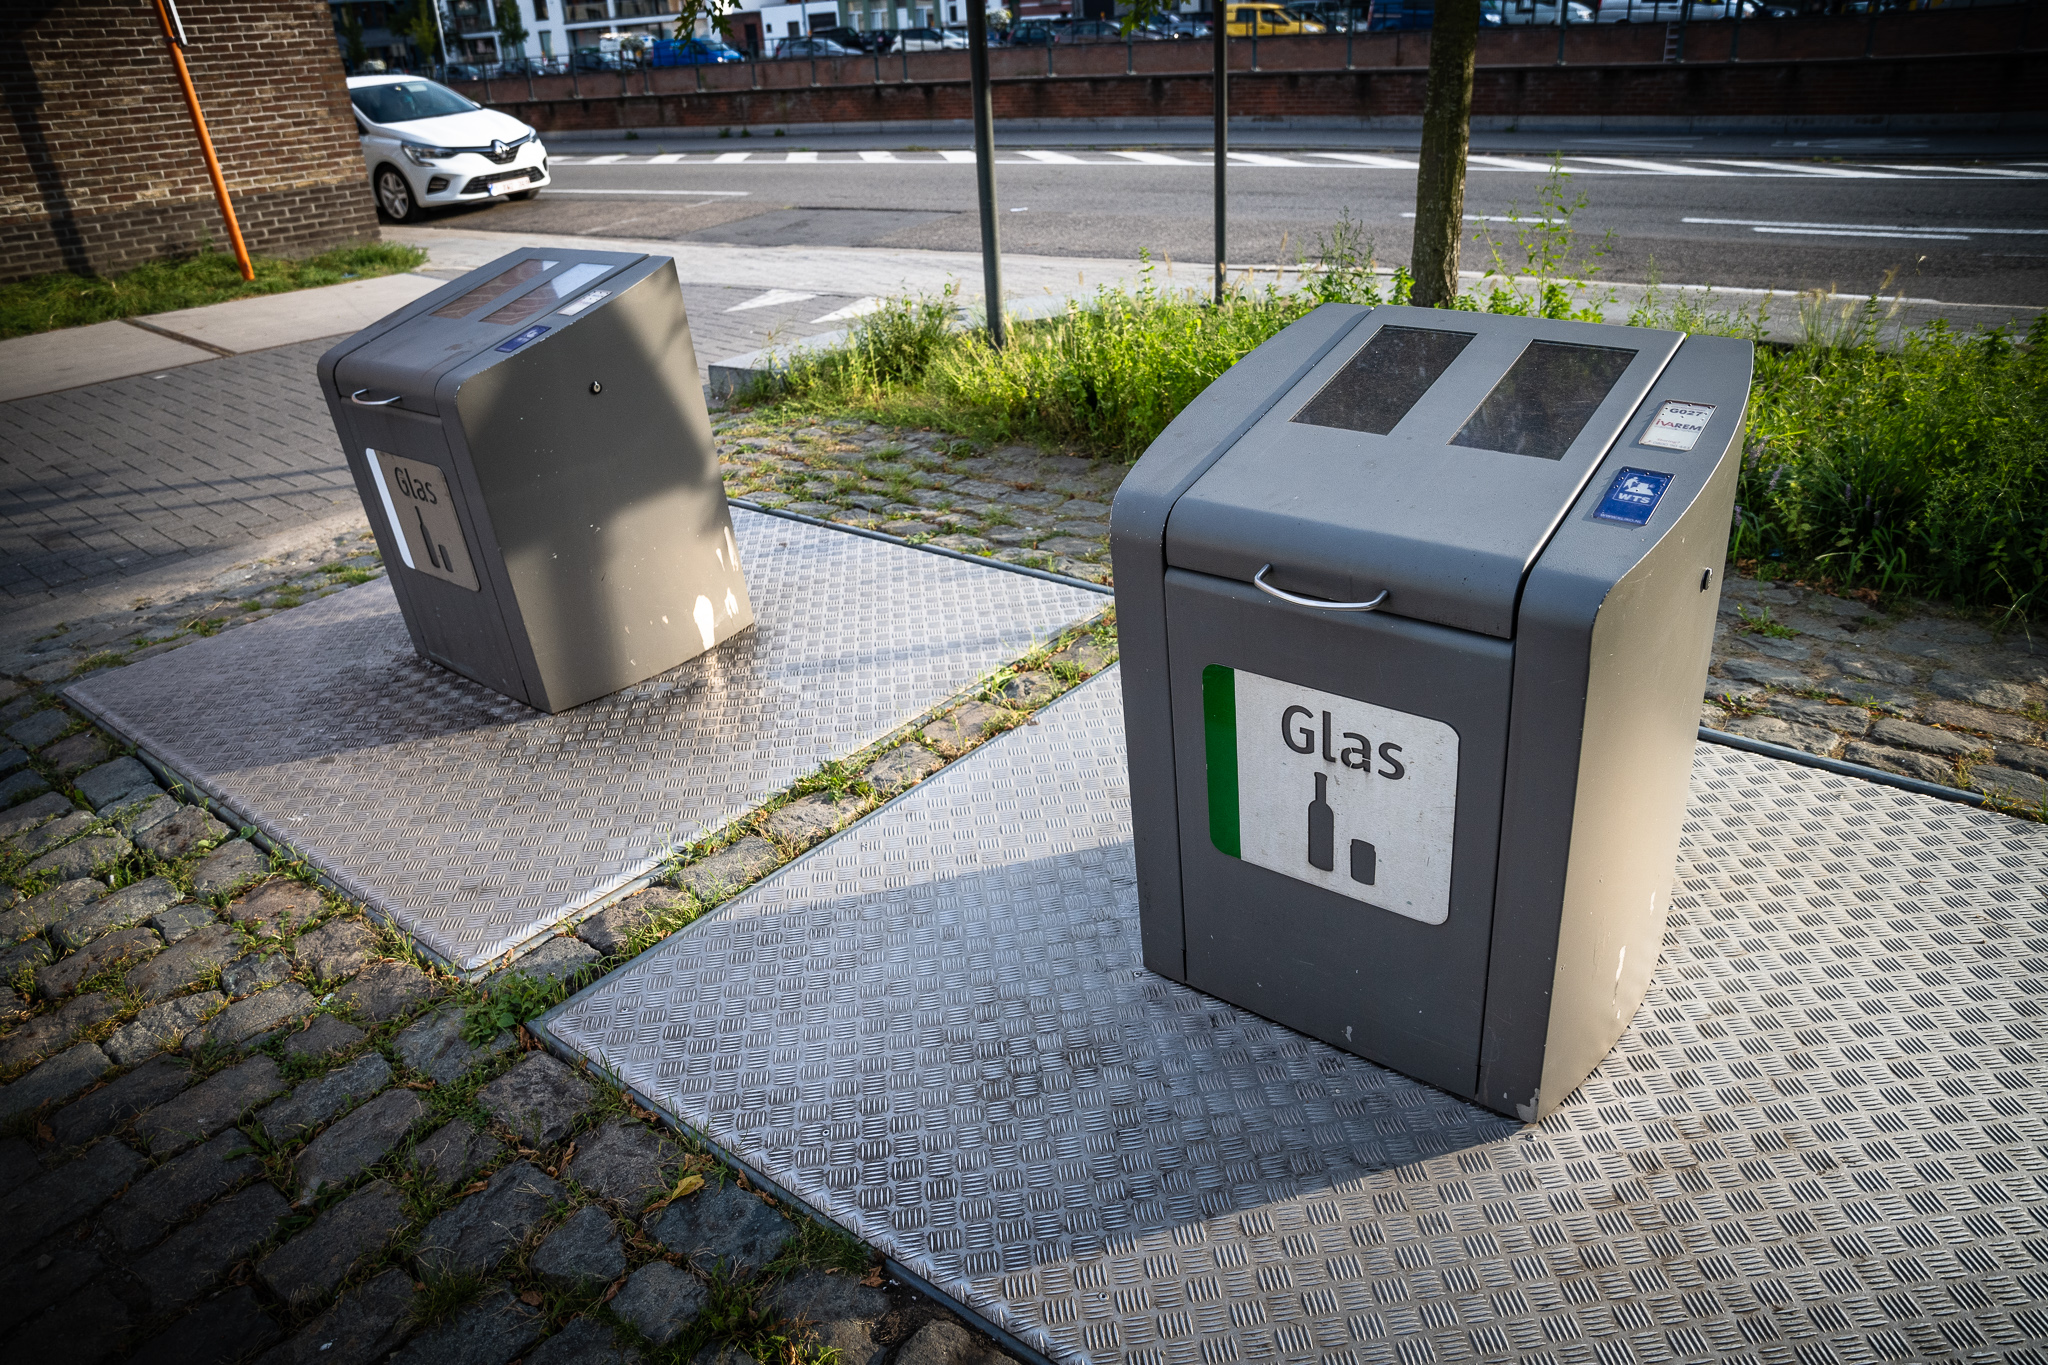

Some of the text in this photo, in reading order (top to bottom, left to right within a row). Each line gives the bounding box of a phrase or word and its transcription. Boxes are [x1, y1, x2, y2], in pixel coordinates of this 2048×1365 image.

[1669, 408, 1703, 416] G027
[394, 466, 438, 505] Glas
[1618, 492, 1650, 504] WTS
[1281, 704, 1405, 780] Glas
